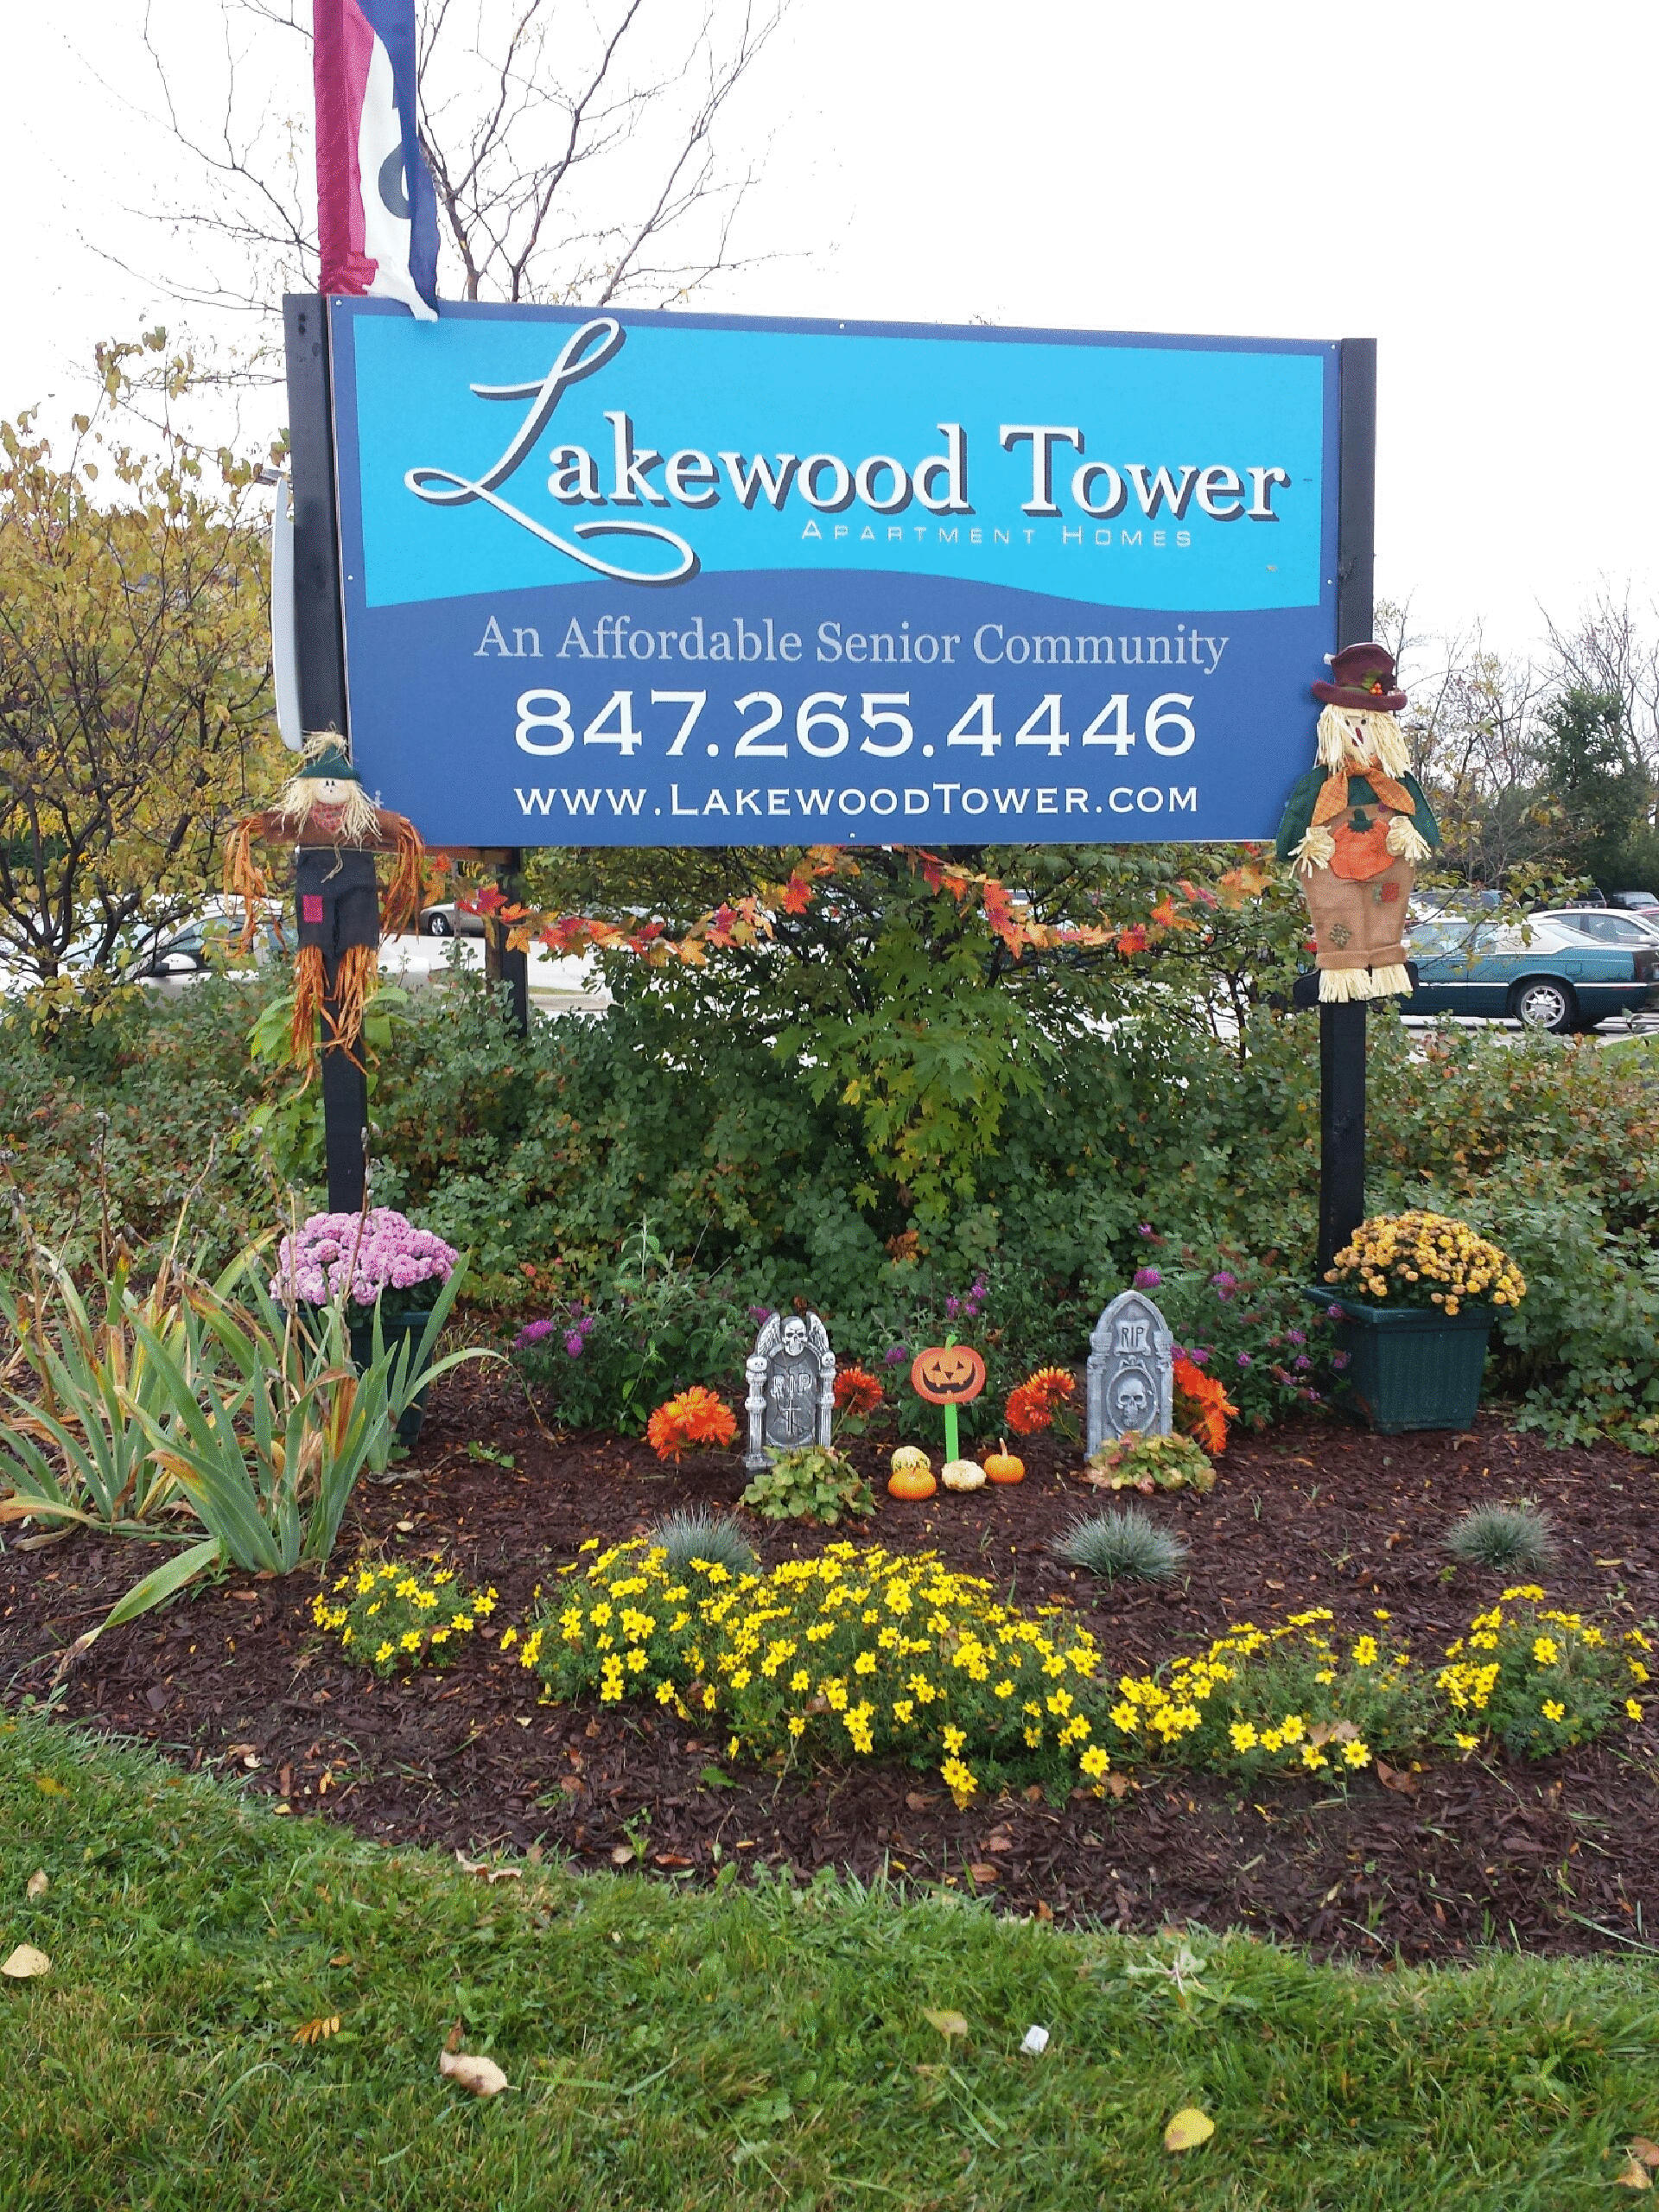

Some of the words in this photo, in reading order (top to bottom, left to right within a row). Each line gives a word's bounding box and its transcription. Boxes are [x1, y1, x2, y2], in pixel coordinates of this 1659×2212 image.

[404, 316, 970, 587] Lakewood
[999, 423, 1293, 522] Tower
[801, 519, 1035, 544] APARTMENT
[1062, 525, 1192, 547] HOMES
[474, 615, 542, 658] An
[556, 615, 804, 663] Affordable
[816, 622, 961, 664] Senior
[973, 623, 1230, 674] Community
[513, 689, 1197, 759] 847.265.4446
[1121, 1326, 1144, 1348] RIP
[770, 1372, 812, 1400] RIP
